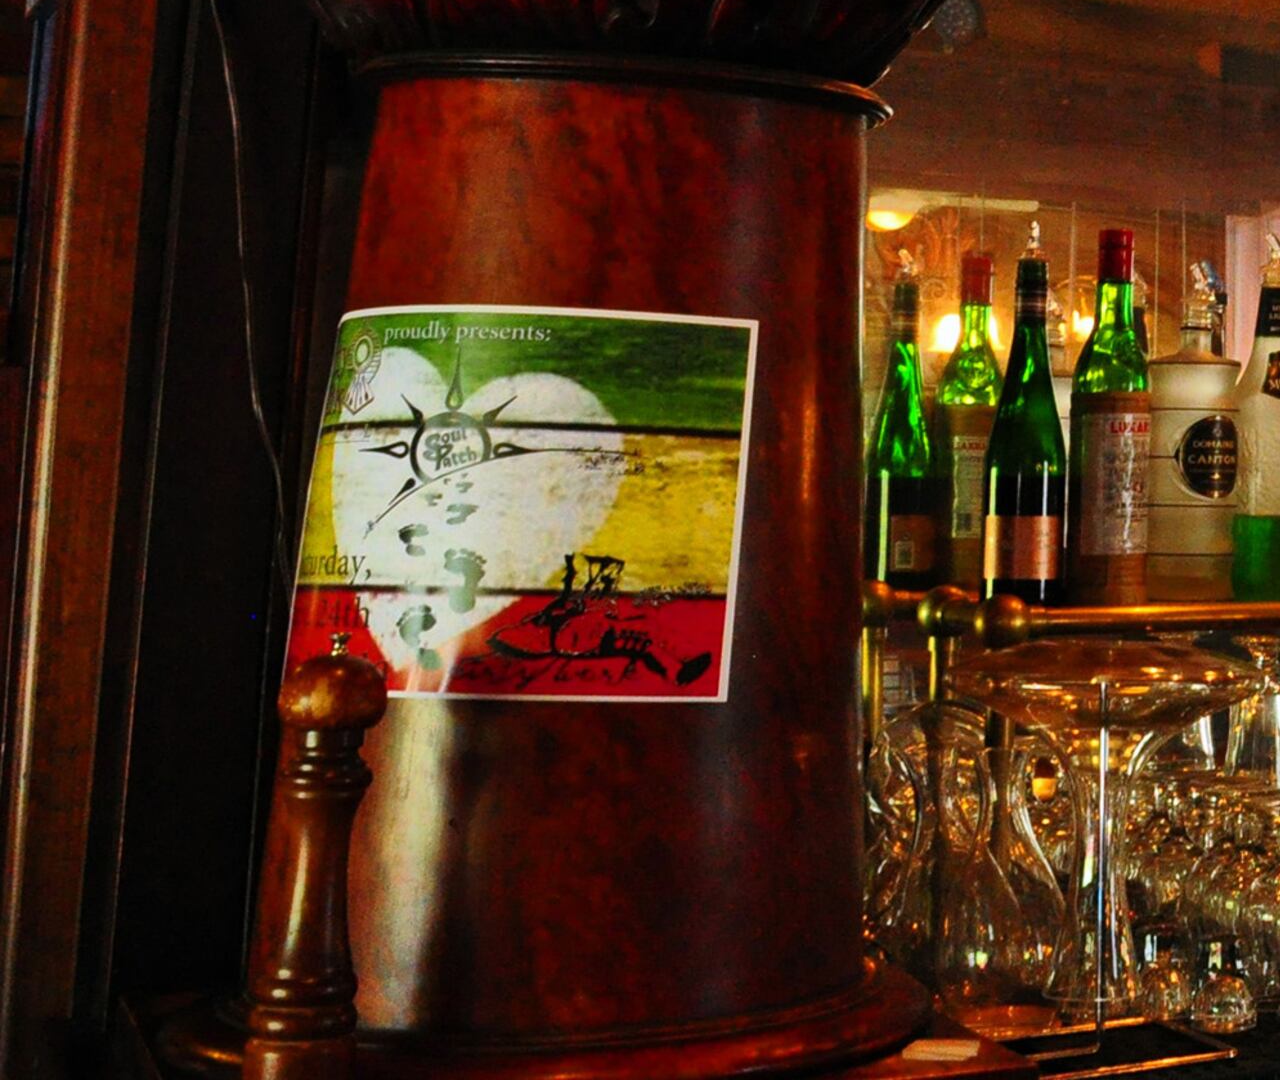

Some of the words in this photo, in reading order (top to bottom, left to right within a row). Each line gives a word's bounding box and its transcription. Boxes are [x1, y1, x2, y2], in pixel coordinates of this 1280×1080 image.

[384, 321, 449, 344] proudly
[424, 428, 467, 458] Soul
[434, 444, 477, 471] Patch
